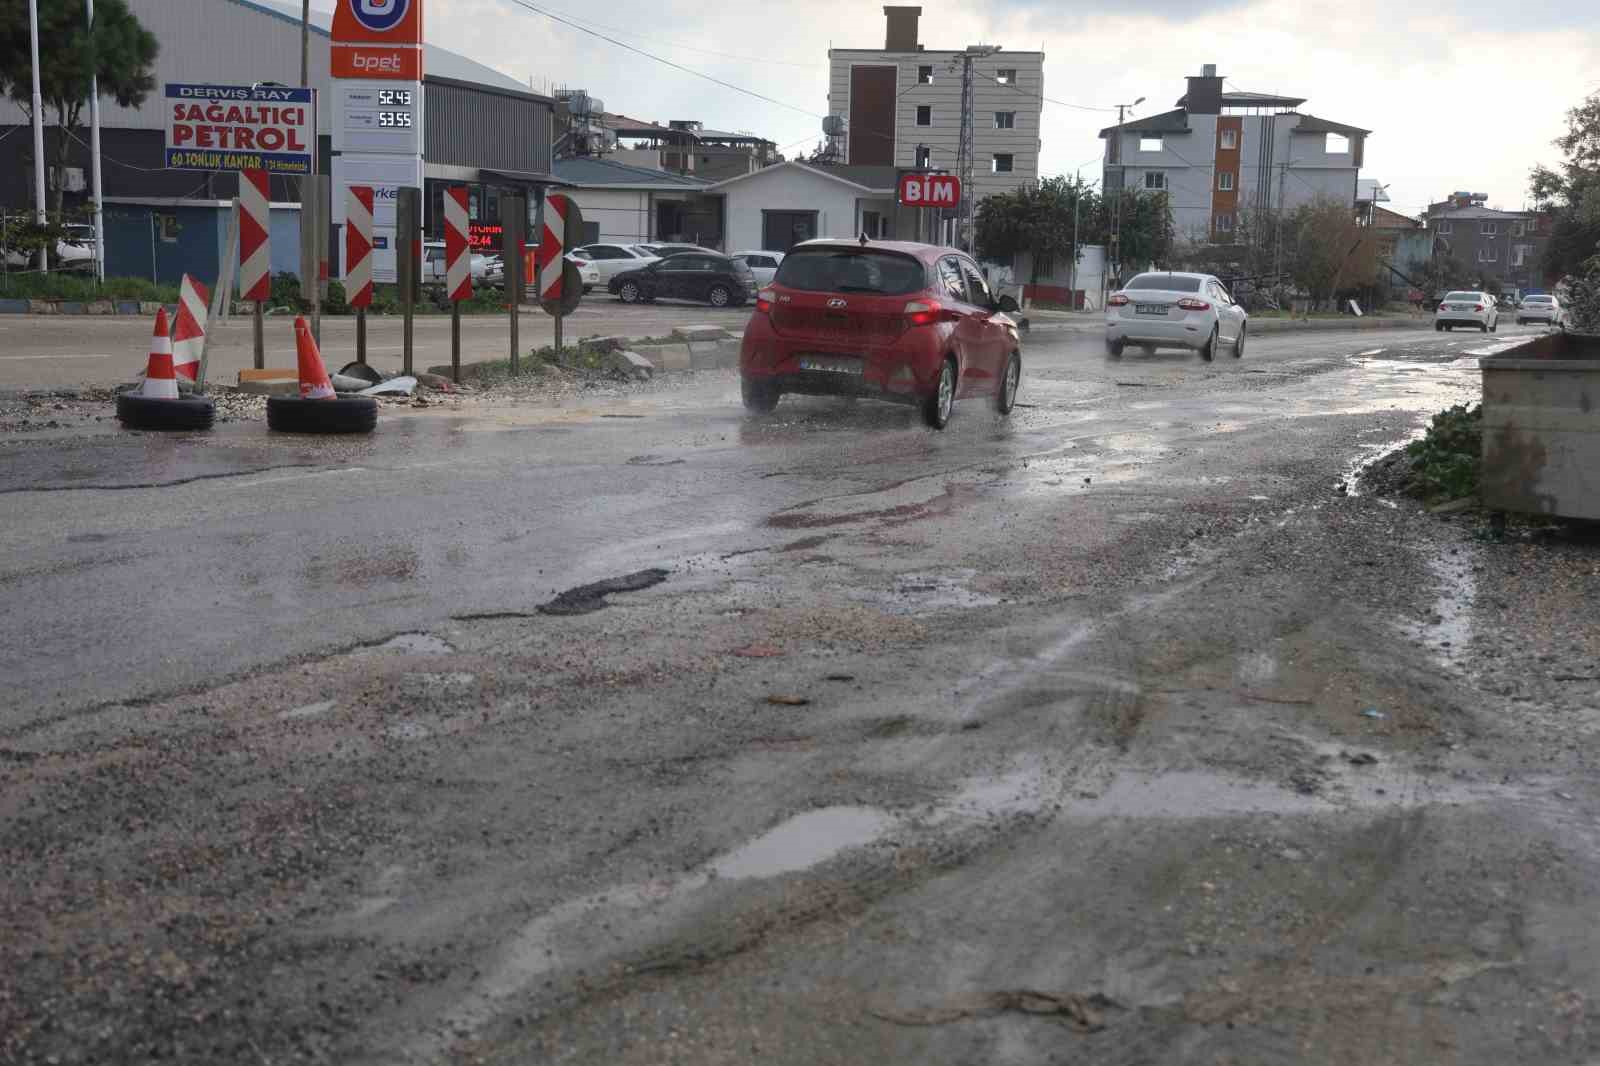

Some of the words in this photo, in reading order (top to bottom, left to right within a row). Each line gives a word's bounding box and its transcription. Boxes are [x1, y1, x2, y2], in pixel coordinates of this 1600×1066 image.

[352, 52, 400, 71] bpet
[254, 90, 293, 100] RAY
[174, 98, 304, 125] SAĞALTICI
[173, 124, 305, 151] PETROL
[223, 153, 262, 169] KANTAR
[905, 176, 953, 202] BİM
